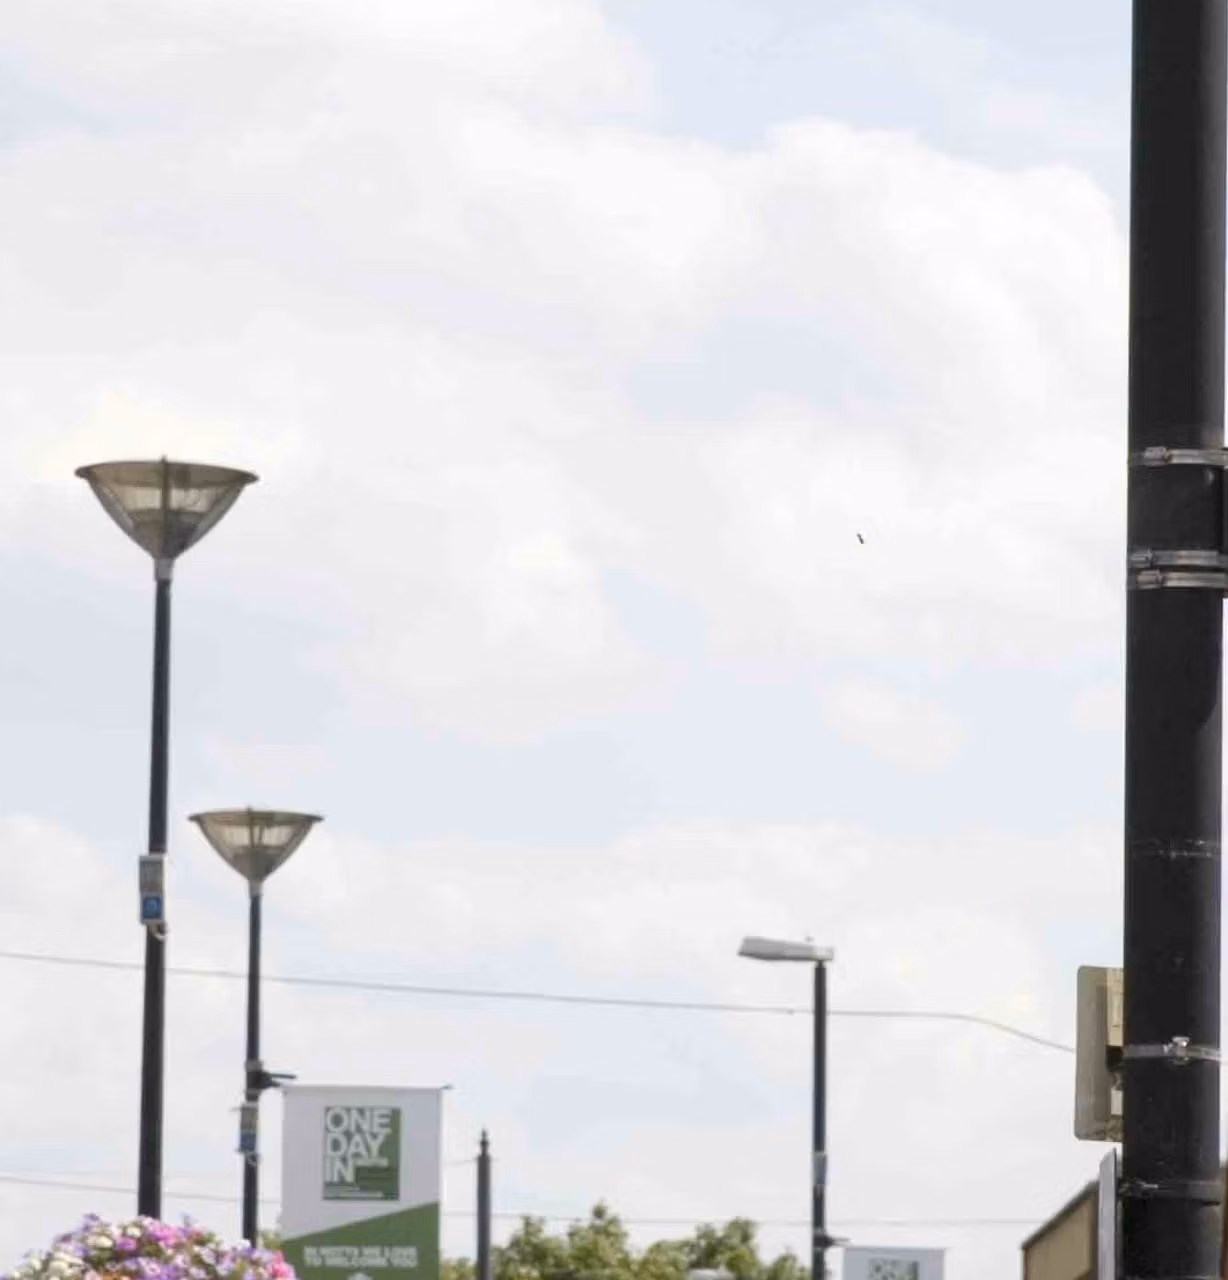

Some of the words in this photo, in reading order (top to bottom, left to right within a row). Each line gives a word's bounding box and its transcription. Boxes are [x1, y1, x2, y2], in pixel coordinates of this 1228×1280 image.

[326, 1108, 392, 1133] ONE
[326, 1134, 386, 1159] DAY
[325, 1156, 355, 1182] IN
